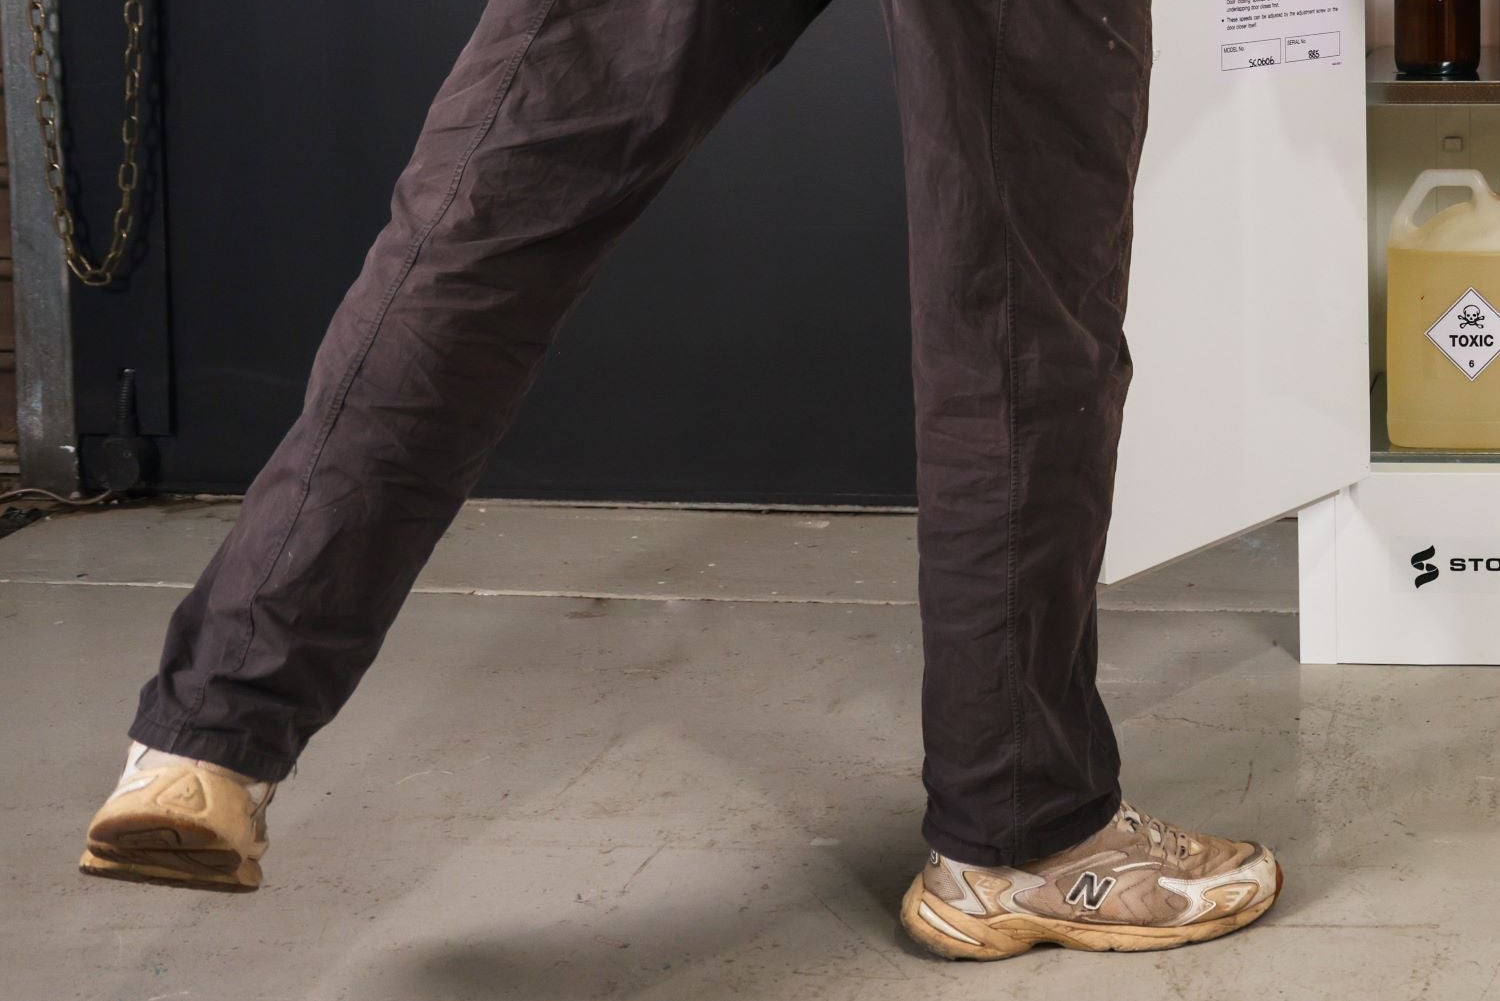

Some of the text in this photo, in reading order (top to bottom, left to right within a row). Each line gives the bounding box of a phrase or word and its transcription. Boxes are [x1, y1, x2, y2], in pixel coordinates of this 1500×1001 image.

[1223, 46, 1238, 54] MODEL
[1449, 334, 1494, 348] TOXIC
[1468, 360, 1475, 368] 6
[1065, 872, 1116, 910] N
